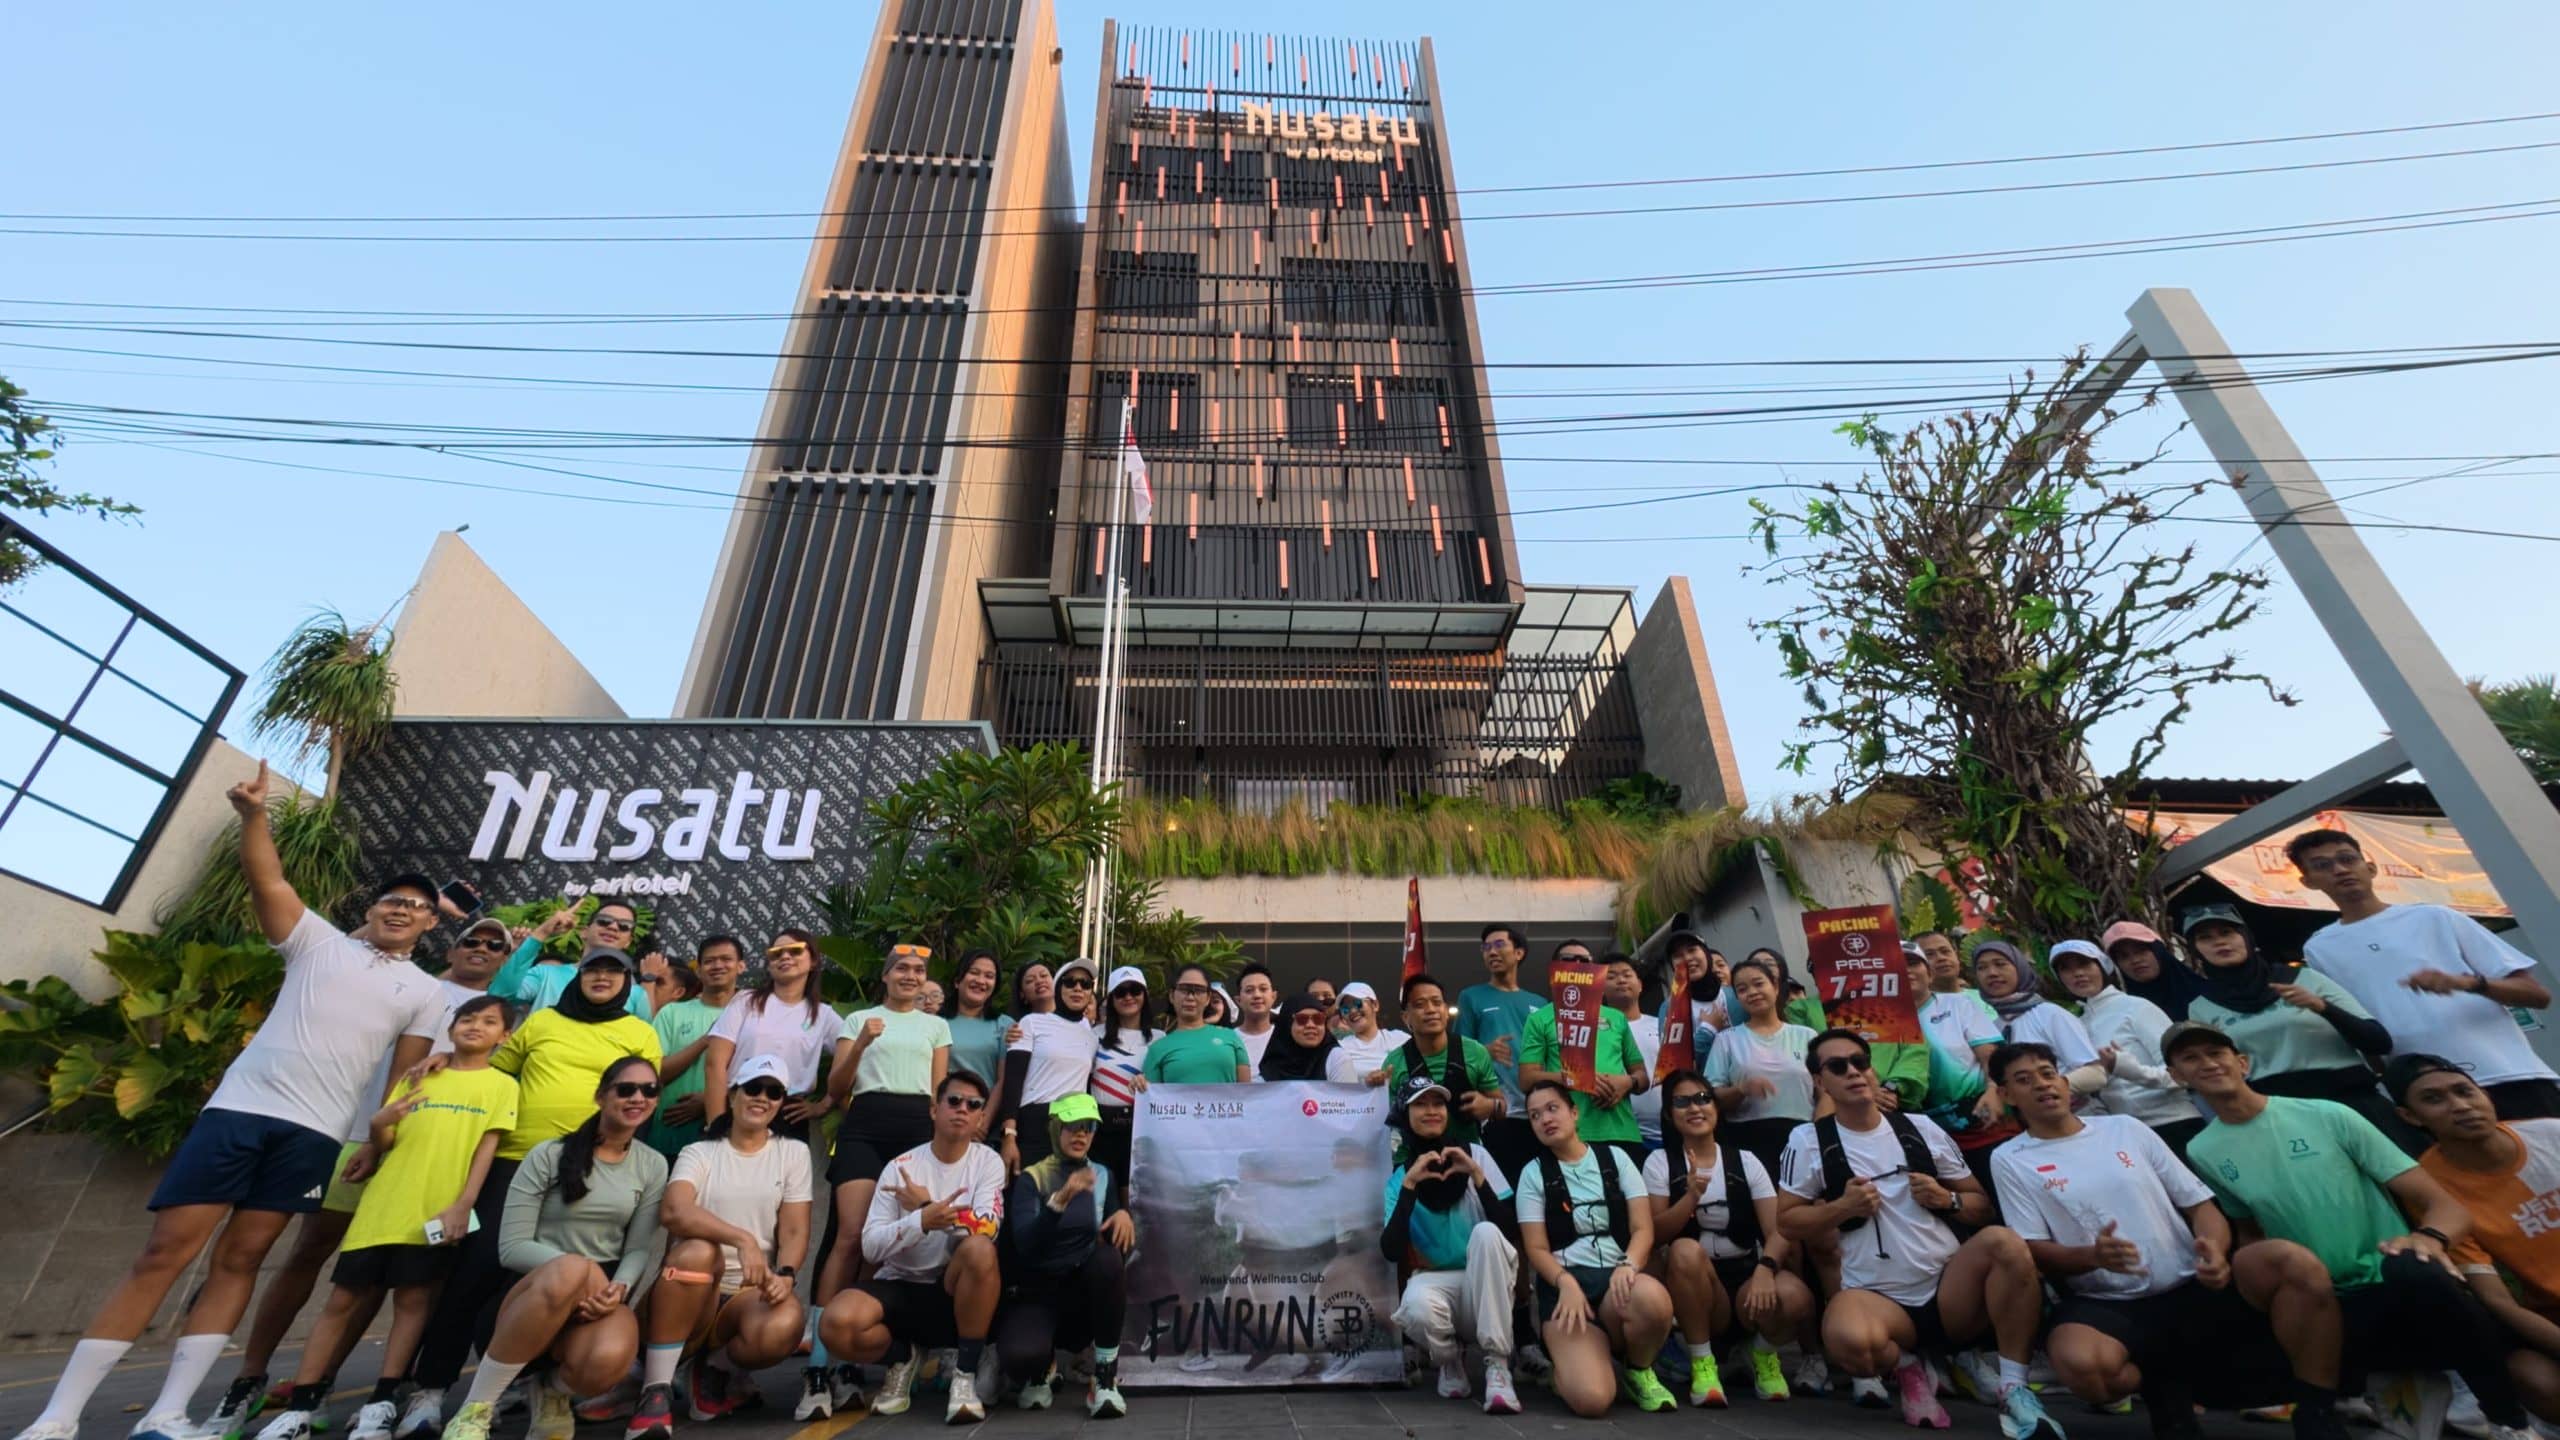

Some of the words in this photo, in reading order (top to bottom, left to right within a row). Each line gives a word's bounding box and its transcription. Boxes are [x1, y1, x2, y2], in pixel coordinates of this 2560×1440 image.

[1241, 100, 1420, 146] Nusatu
[1306, 147, 1383, 164] artotel
[468, 771, 822, 862] Nusatu
[590, 872, 692, 896] artotel
[1818, 916, 1880, 934] PACING
[1835, 957, 1885, 971] PACE
[1554, 970, 1594, 985] PACING
[1830, 973, 1899, 1000] 7.30
[1559, 1008, 1585, 1021] PACE
[1150, 1102, 1187, 1116] Nusatu
[1208, 1102, 1244, 1113] AKAR
[2288, 1138, 2310, 1153] 23
[1251, 1272, 1298, 1284] Wellness
[1300, 1271, 1325, 1284] Club
